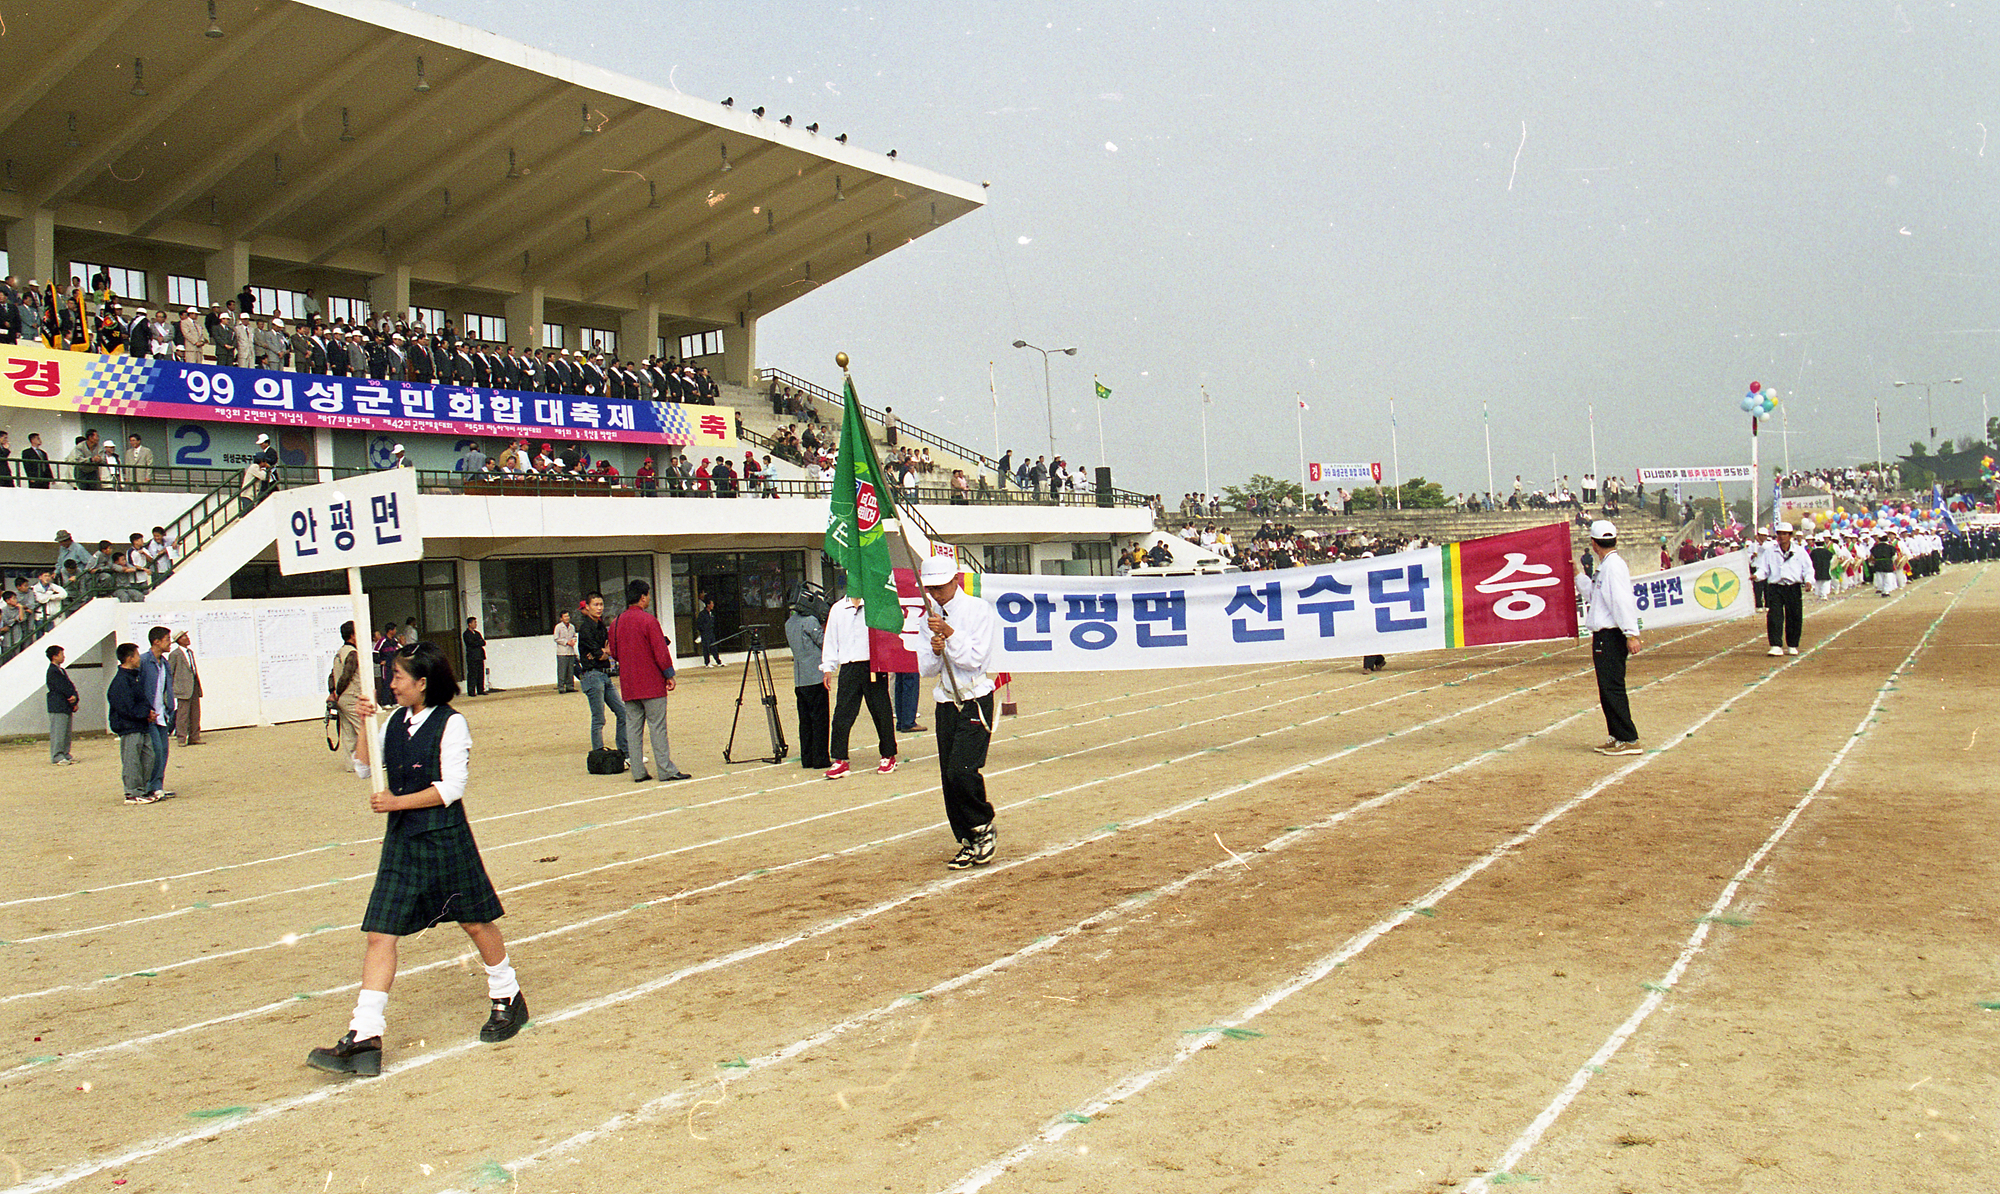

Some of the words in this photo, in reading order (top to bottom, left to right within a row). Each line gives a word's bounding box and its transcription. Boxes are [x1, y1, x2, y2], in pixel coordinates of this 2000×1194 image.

[3, 357, 61, 397] 경
[180, 369, 235, 404] '99
[252, 377, 436, 419] 의성군민
[448, 392, 524, 424] 화합
[534, 398, 636, 430] 대축제
[174, 424, 213, 466] 2
[214, 407, 241, 419] 제3회
[278, 411, 308, 425] 기념식,
[382, 418, 411, 430] 제42회
[464, 422, 485, 433] 제5회
[699, 413, 728, 440] 축
[291, 492, 402, 557] 안평면
[996, 589, 1189, 653] 안평면
[1224, 563, 1430, 645] 선수단
[1475, 553, 1561, 621] 승
